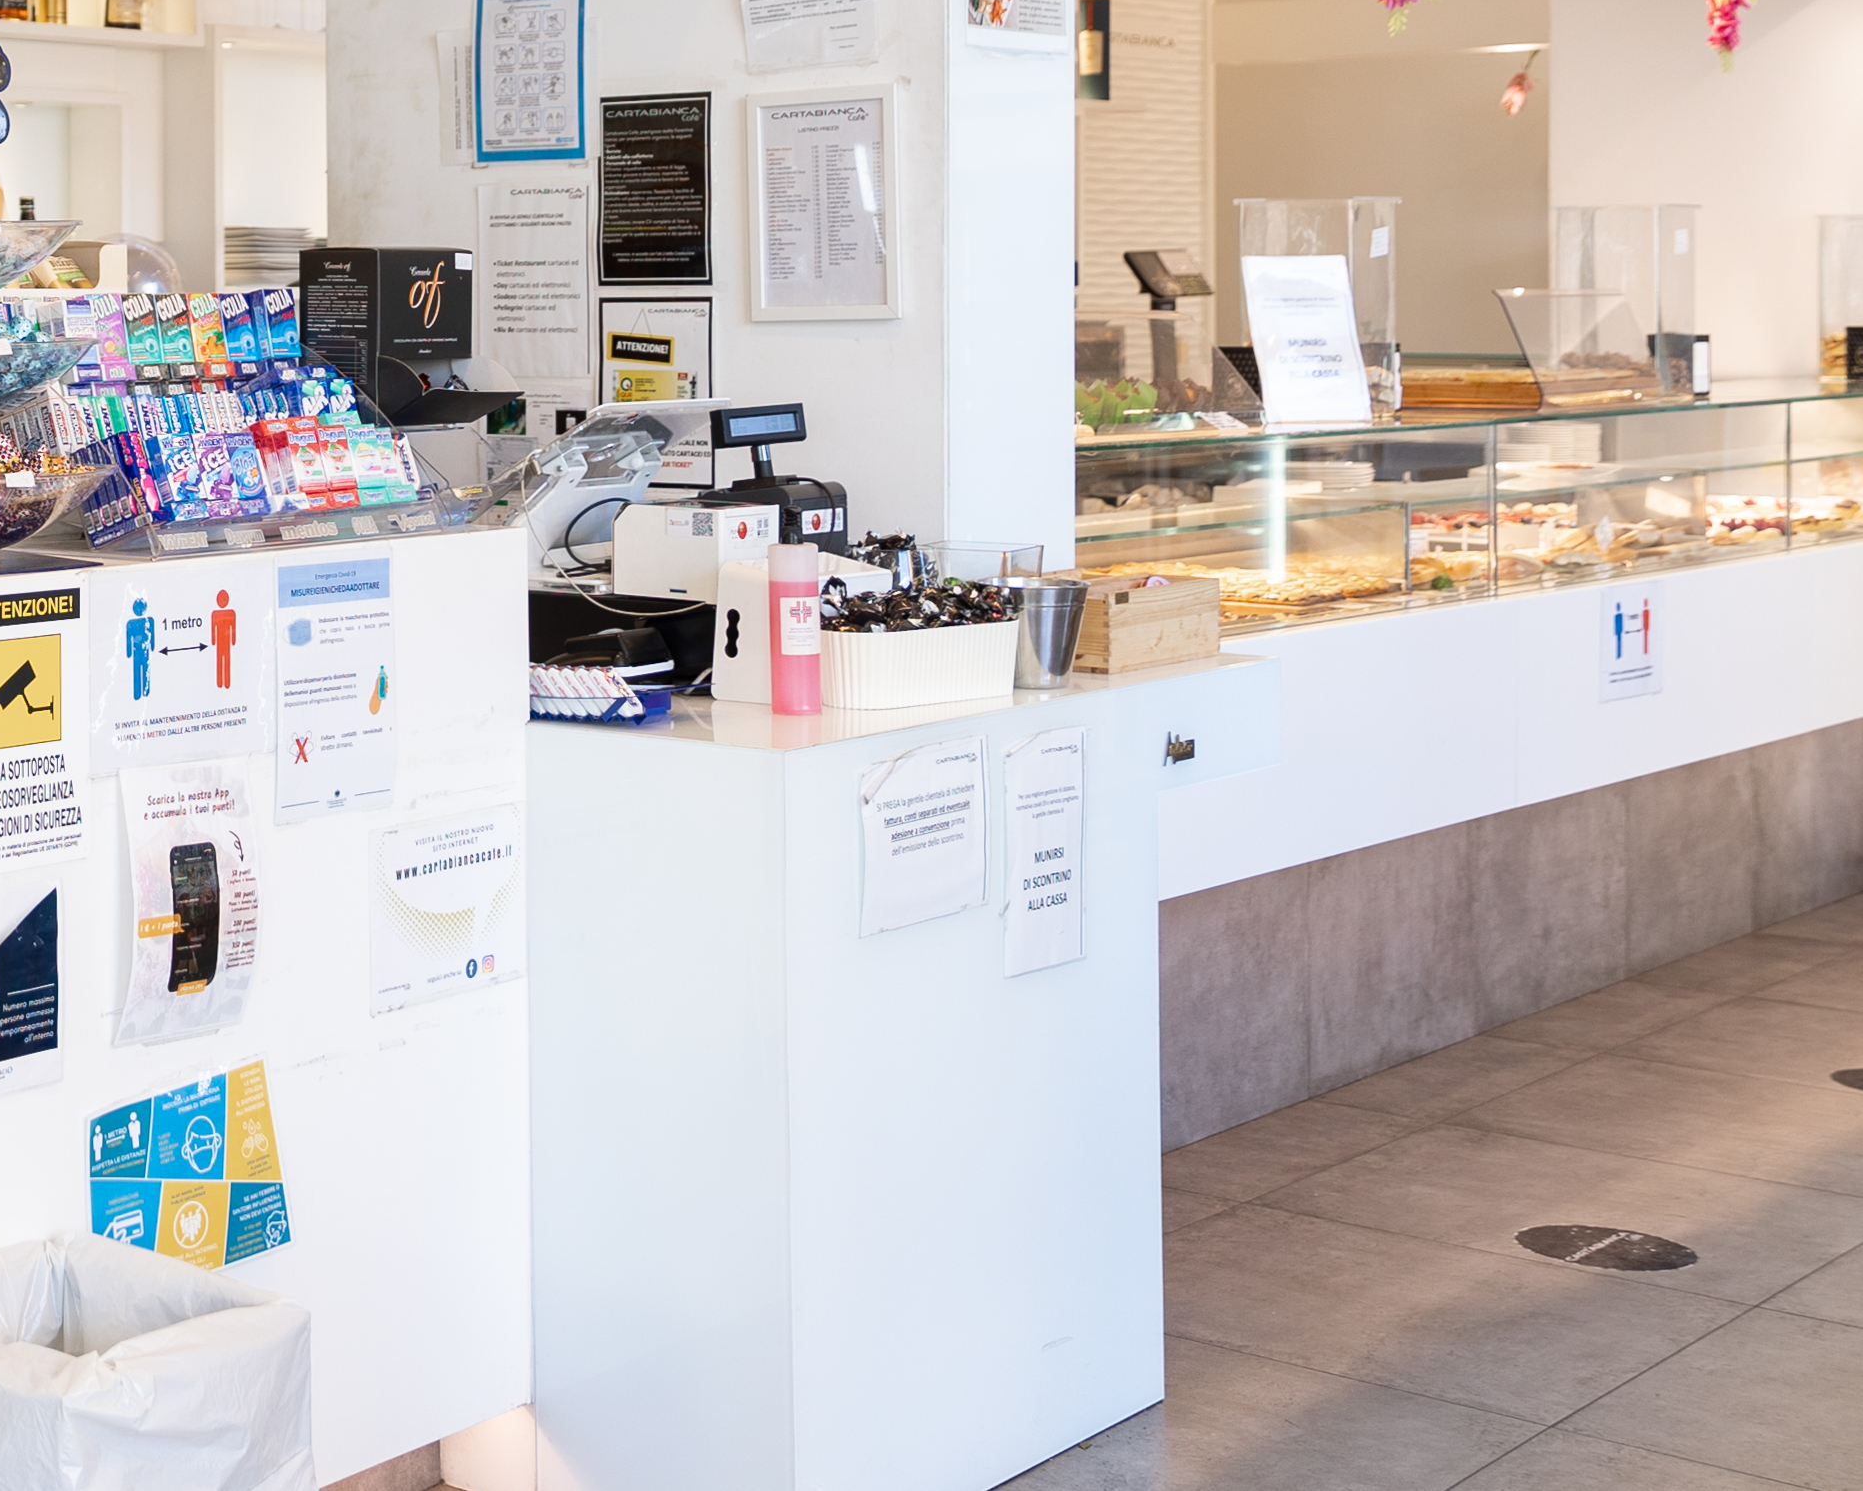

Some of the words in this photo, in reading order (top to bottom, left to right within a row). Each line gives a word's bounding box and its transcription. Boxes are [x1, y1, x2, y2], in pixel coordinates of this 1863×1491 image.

[606, 107, 699, 118] CARTABIANCA
[771, 107, 865, 119] CARTABIANCA
[510, 188, 582, 196] CARTABIANCA
[264, 289, 295, 315] GOLIA
[409, 261, 445, 328] of
[123, 294, 154, 322] GOLIA
[157, 293, 186, 321] GOLIA
[189, 293, 219, 320] GOLIA
[221, 293, 249, 320] GOLIA
[616, 341, 669, 354] ATTENZIONE!
[289, 431, 316, 444] Daygum
[319, 428, 345, 441] Daygum
[348, 429, 375, 440] Daygum
[167, 450, 193, 471] ICE
[202, 449, 226, 471] ICE
[280, 521, 338, 539] mentos
[162, 618, 167, 630] 1
[172, 617, 202, 630] metro
[202, 710, 216, 719] DELLA
[218, 707, 241, 716] DISTANZA
[147, 729, 166, 739] METRO
[168, 727, 183, 736] DALLE
[185, 725, 200, 733] ALTRE
[201, 722, 222, 731] PERSONE
[8, 754, 65, 780] SOTTOPOSTA
[147, 795, 175, 806] Scarica
[178, 791, 185, 802] la
[188, 791, 212, 802] nostra
[215, 788, 230, 799] App
[877, 803, 882, 812] SI
[883, 799, 900, 810] PREGA
[907, 795, 924, 807] gentile
[925, 790, 945, 802] clientela
[952, 784, 975, 795] richiedere
[946, 800, 970, 811] eventuale
[25, 814, 32, 833] DI
[35, 806, 82, 831] SICUREZZA
[144, 812, 148, 820] e
[151, 807, 187, 820] accumula
[195, 802, 209, 814] tuoi
[212, 799, 235, 816] punti!
[415, 836, 435, 846] VISITA
[445, 829, 470, 840] NOSTRO
[471, 824, 494, 834] NUOVO
[892, 829, 913, 840] adesione
[919, 820, 950, 833] convenzione
[951, 817, 965, 827] prima
[432, 843, 447, 852] SITO
[449, 837, 479, 849] INTERNET
[396, 845, 512, 881] www.cartabiancacafe.it
[1035, 846, 1064, 864] MUNIRSI
[1023, 879, 1031, 890] DI
[1032, 869, 1072, 889] SCONTRINO
[1028, 898, 1044, 912] ALLA
[1046, 892, 1068, 908] CASSA
[2, 1000, 27, 1012] Numero
[29, 995, 55, 1006] massimo
[0, 1013, 24, 1027] persone
[26, 1007, 55, 1019] ammesse
[24, 1030, 54, 1044] all'interno
[109, 1126, 128, 1139] METRO
[92, 1157, 114, 1172] RISPETTA
[114, 1155, 120, 1164] LE
[121, 1149, 146, 1162] DISTANZE
